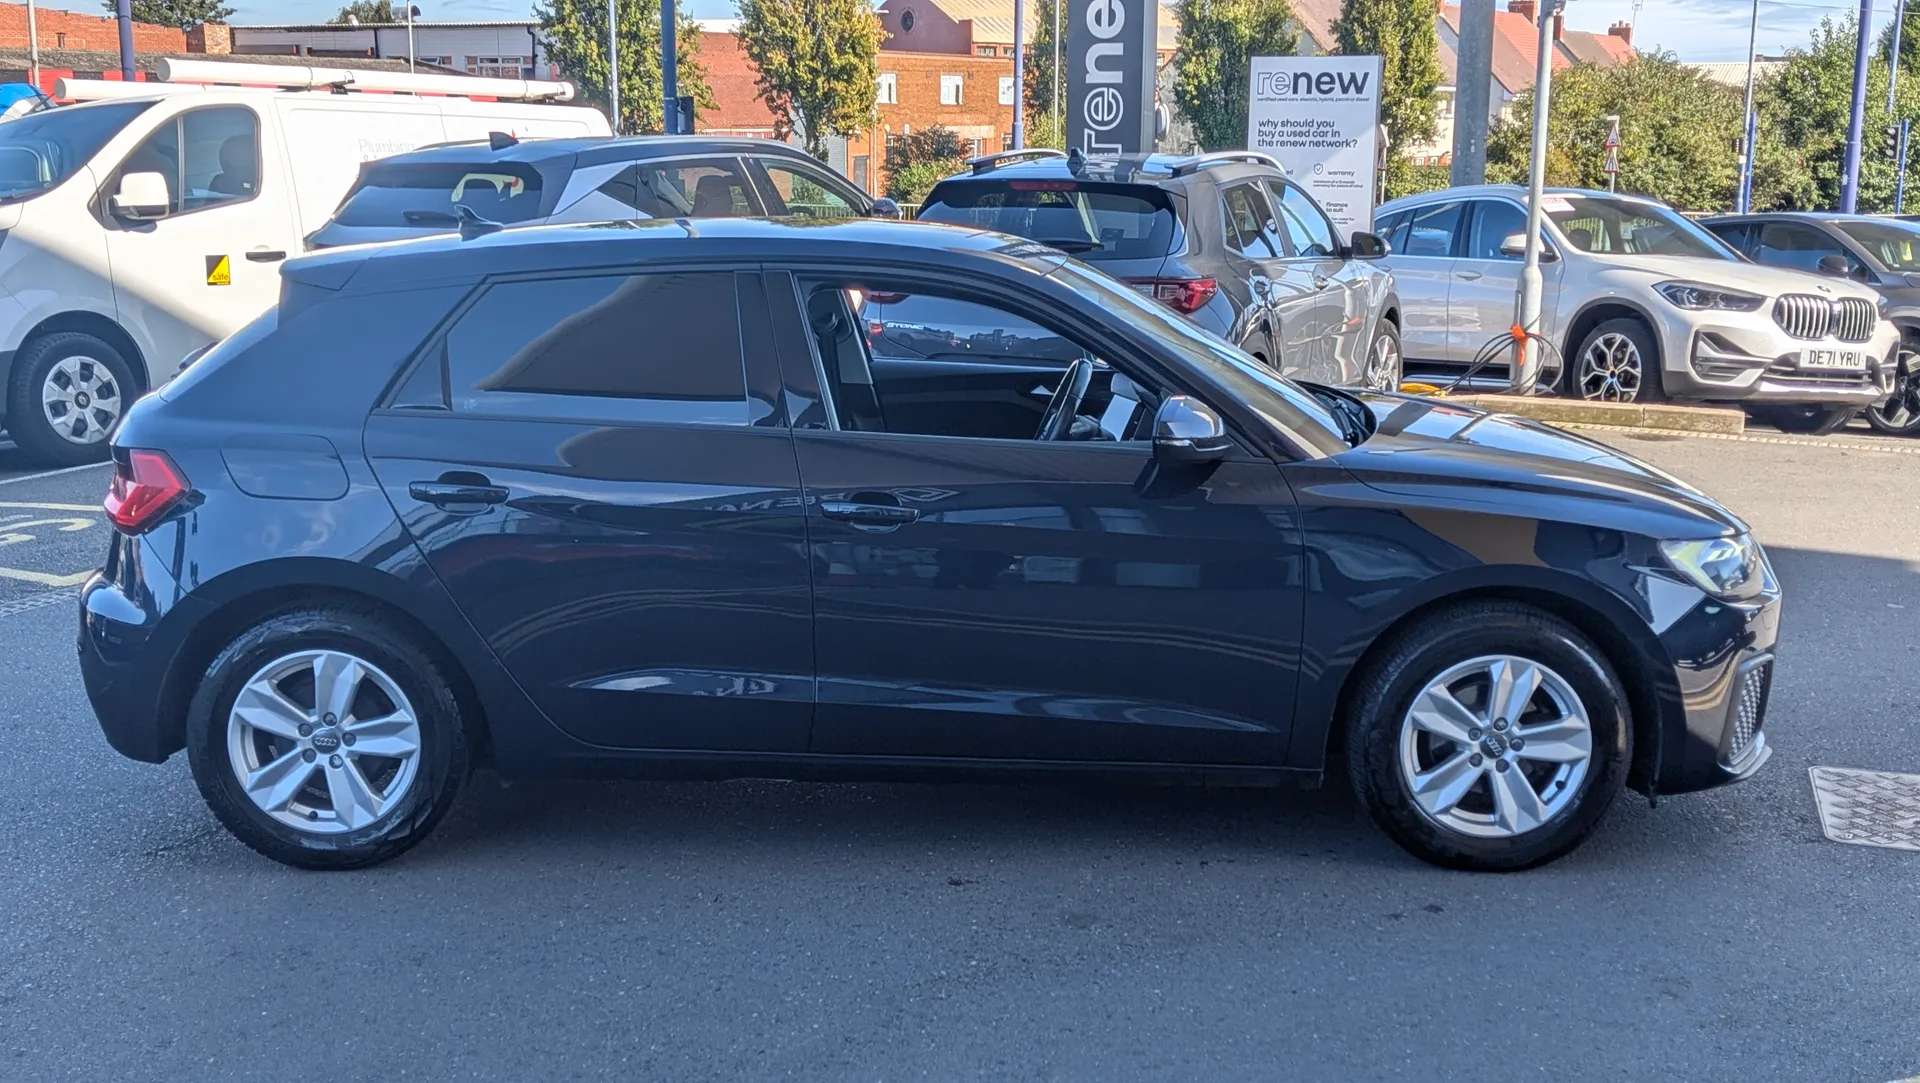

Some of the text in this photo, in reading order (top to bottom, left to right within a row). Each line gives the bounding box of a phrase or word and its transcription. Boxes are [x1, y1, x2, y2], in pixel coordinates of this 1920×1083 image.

[1257, 71, 1369, 95] renew
[1258, 118, 1335, 130] why should you
[1257, 128, 1277, 139] buy
[1286, 128, 1310, 137] used
[1331, 128, 1341, 137] in
[1257, 138, 1358, 148] the renew network?
[1808, 350, 1861, 367] DE71 YRU
